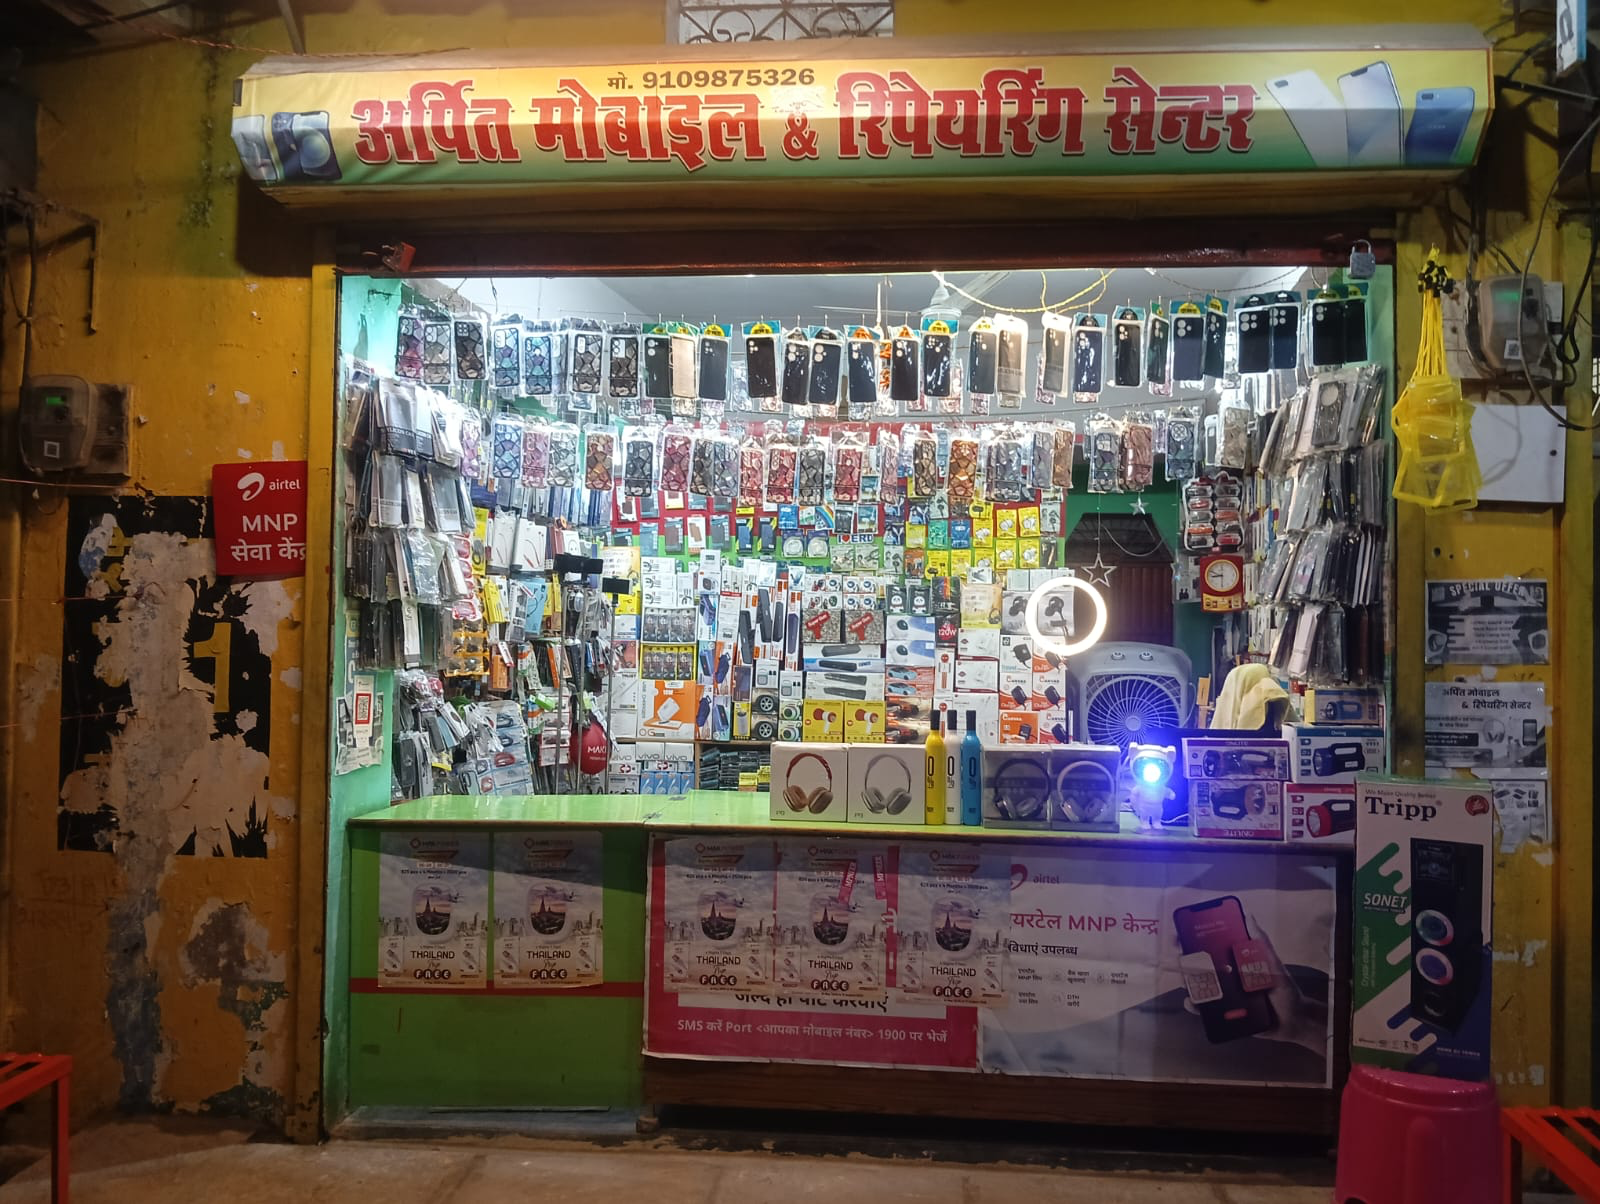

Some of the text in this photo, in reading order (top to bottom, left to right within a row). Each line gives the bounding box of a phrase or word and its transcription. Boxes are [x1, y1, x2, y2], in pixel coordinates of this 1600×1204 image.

[642, 68, 816, 89] 9109875326
[352, 66, 1256, 172] अर्पित मोबाइल & रिपेयरिंग सेन्टर
[268, 479, 301, 491] airtel
[242, 513, 298, 533] MNP
[851, 534, 873, 543] ERD
[230, 538, 272, 561] सेवा
[1449, 581, 1491, 597] SPECIAL
[638, 752, 660, 760] vivo
[665, 753, 688, 761] vivo
[1365, 796, 1437, 821] Tripp
[1032, 873, 1060, 885] airtel
[1363, 892, 1407, 908] SONET
[1010, 908, 1063, 930] यरटेल
[1068, 915, 1117, 933] MNP
[410, 950, 456, 960] THAILAND
[526, 950, 572, 960] THAILAND
[1041, 943, 1078, 957] उपलब्ध
[695, 955, 741, 967] THAILAND
[807, 959, 854, 971] THAILAND
[414, 968, 452, 980] FREE
[530, 968, 568, 980] FREE
[929, 966, 977, 978] THAILAND
[699, 973, 738, 987] FREE
[810, 979, 850, 993] FREE
[933, 985, 973, 999] FREE
[677, 1019, 704, 1031] SMS
[725, 1020, 753, 1034] Port
[802, 1022, 842, 1039] मोबाइल
[878, 1028, 906, 1041] 1900
[909, 1030, 923, 1042] पर
